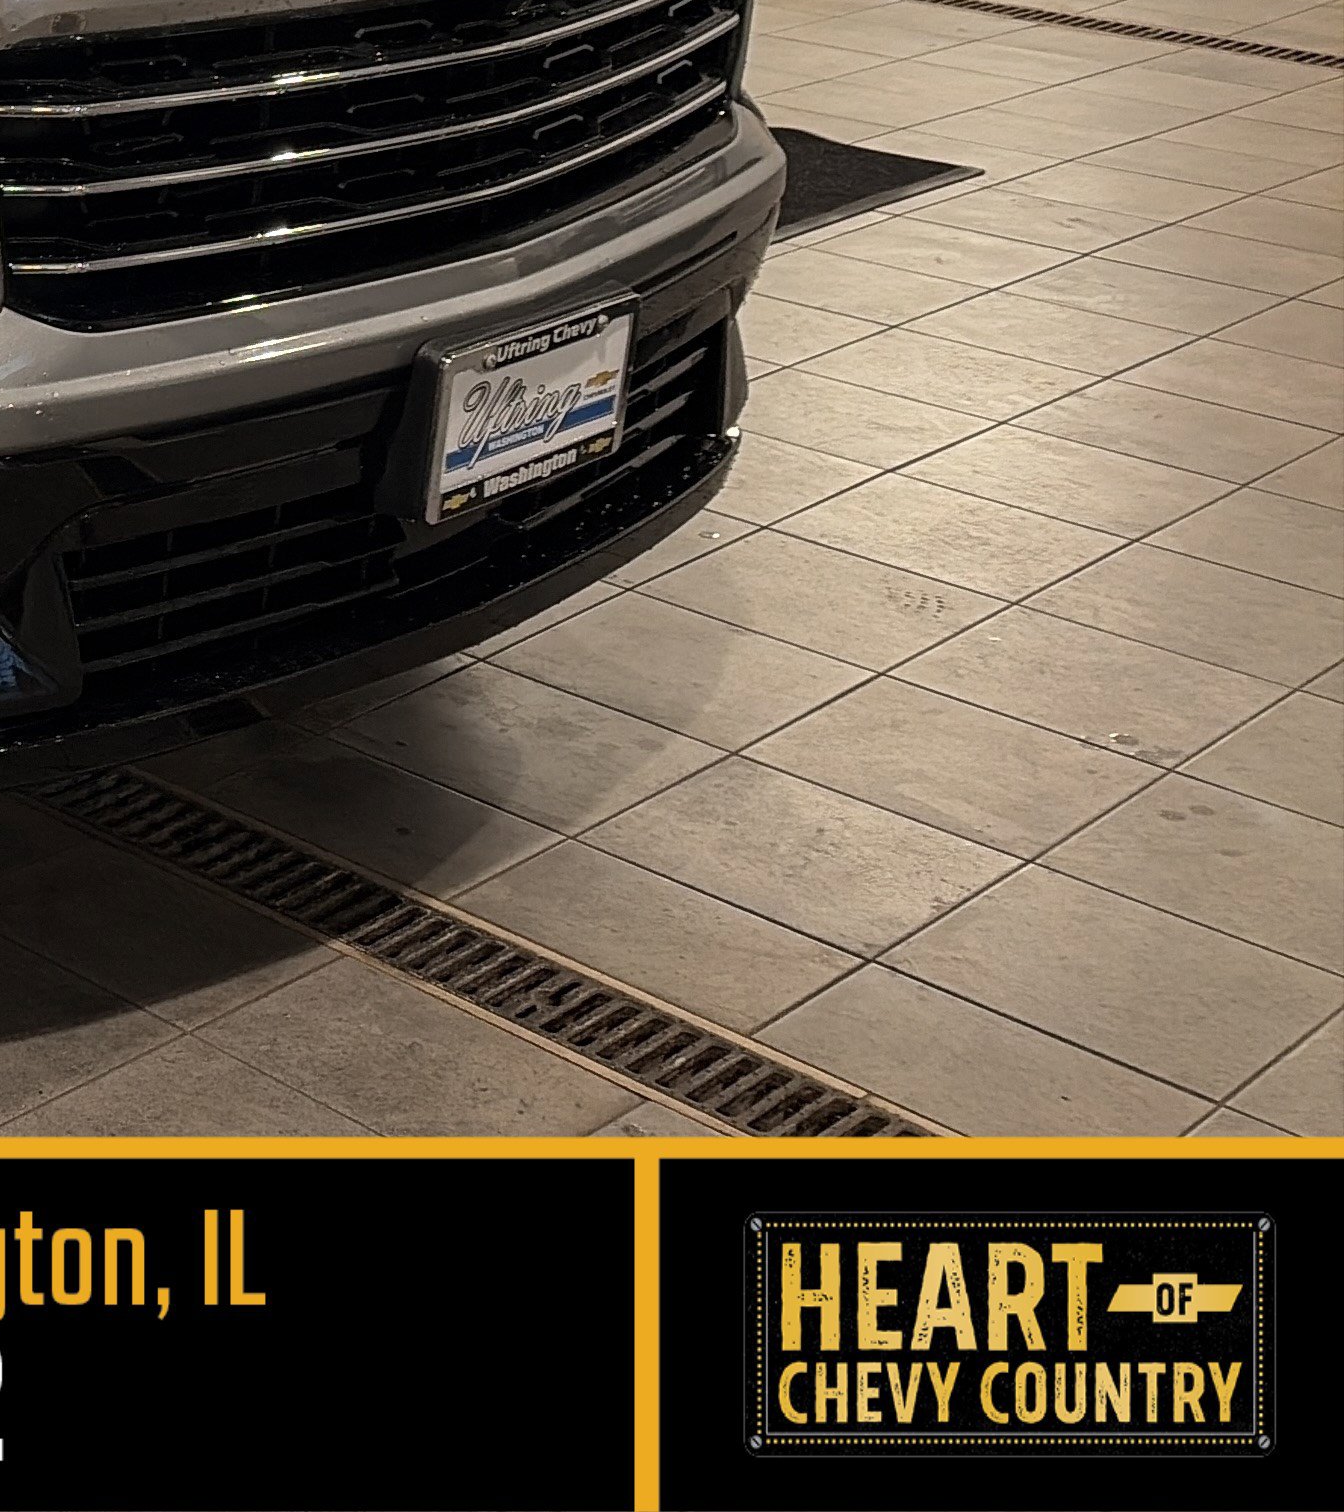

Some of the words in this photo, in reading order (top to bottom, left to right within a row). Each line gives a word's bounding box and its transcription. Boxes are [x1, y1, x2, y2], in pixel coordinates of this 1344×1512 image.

[497, 336, 550, 363] Uftring
[553, 317, 597, 344] Chevy
[459, 376, 582, 469] Uftring
[487, 423, 545, 452] WASHINGTON
[482, 448, 578, 498] Washington
